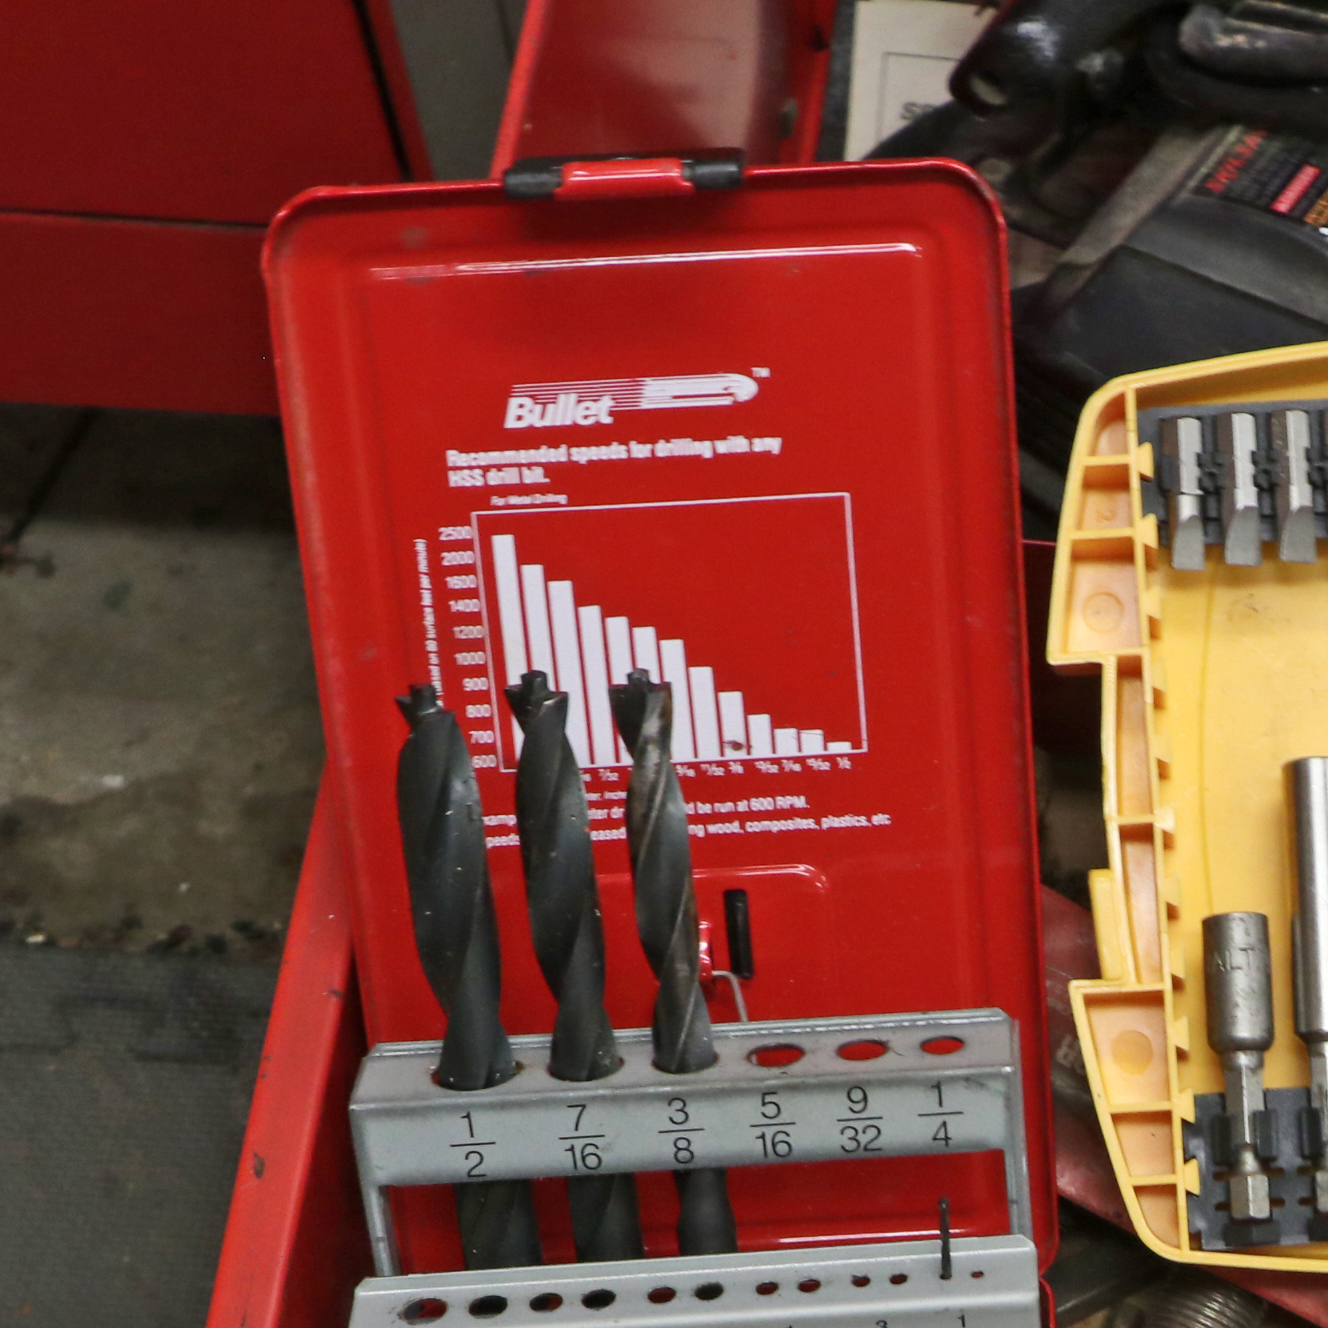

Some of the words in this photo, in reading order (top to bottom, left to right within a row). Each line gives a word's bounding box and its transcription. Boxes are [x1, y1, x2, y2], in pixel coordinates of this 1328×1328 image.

[504, 392, 614, 429] Bullet
[446, 444, 568, 467] Recommended
[569, 442, 628, 464] speeds
[629, 440, 652, 458] for
[654, 437, 713, 459] drilling
[715, 435, 750, 454] with
[751, 437, 782, 455] any
[448, 469, 484, 487] HSS
[486, 467, 520, 485] drill
[438, 526, 472, 541] 2500
[440, 551, 475, 566] 2000
[449, 599, 481, 612] 1400
[452, 625, 484, 639] 1200
[454, 652, 486, 665] 1000
[469, 730, 494, 744] 700
[472, 755, 497, 768] 600
[698, 801, 712, 815] be
[714, 801, 735, 813] run
[736, 799, 749, 812] at
[745, 815, 818, 832] composites,
